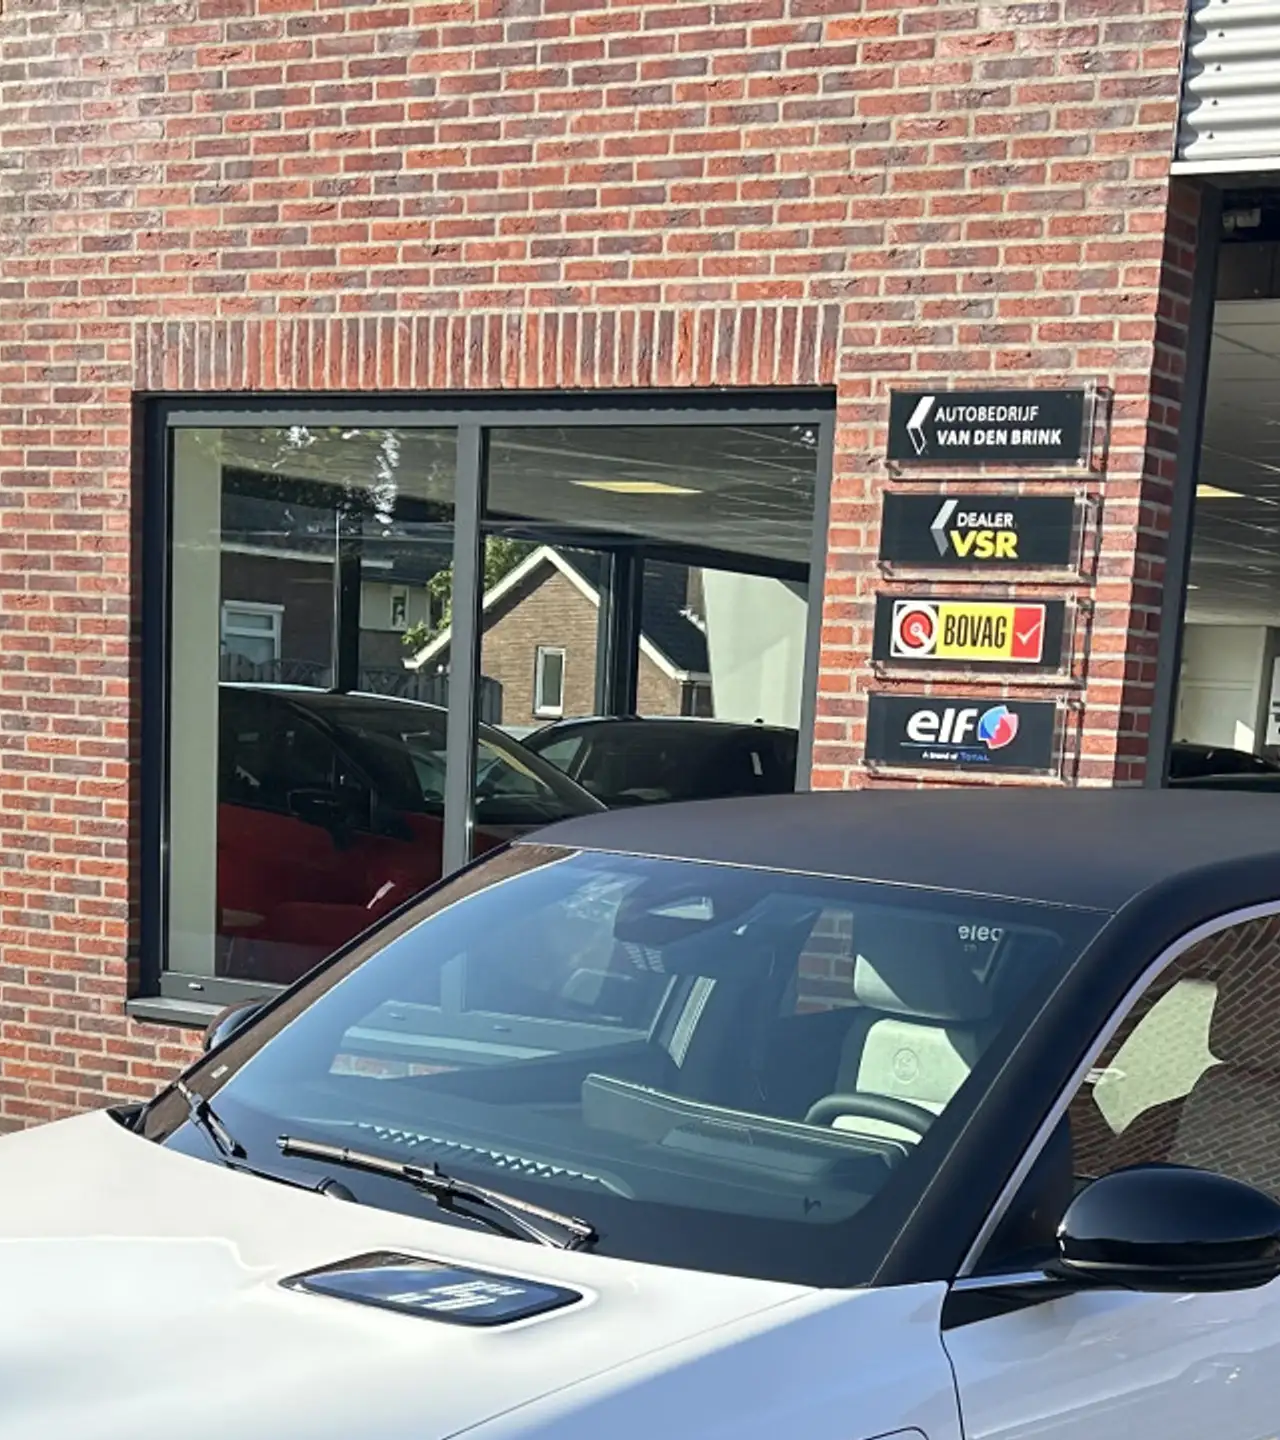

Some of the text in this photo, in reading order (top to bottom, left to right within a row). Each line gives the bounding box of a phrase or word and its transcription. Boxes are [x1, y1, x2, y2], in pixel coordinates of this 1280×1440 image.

[934, 405, 1040, 423] AUTOBEDRIJF
[936, 428, 1063, 446] VAN DEN BRINK
[957, 512, 1014, 528] DEALER
[950, 530, 1018, 558] VSR
[943, 614, 1007, 649] BOVAG
[906, 708, 979, 743] elf
